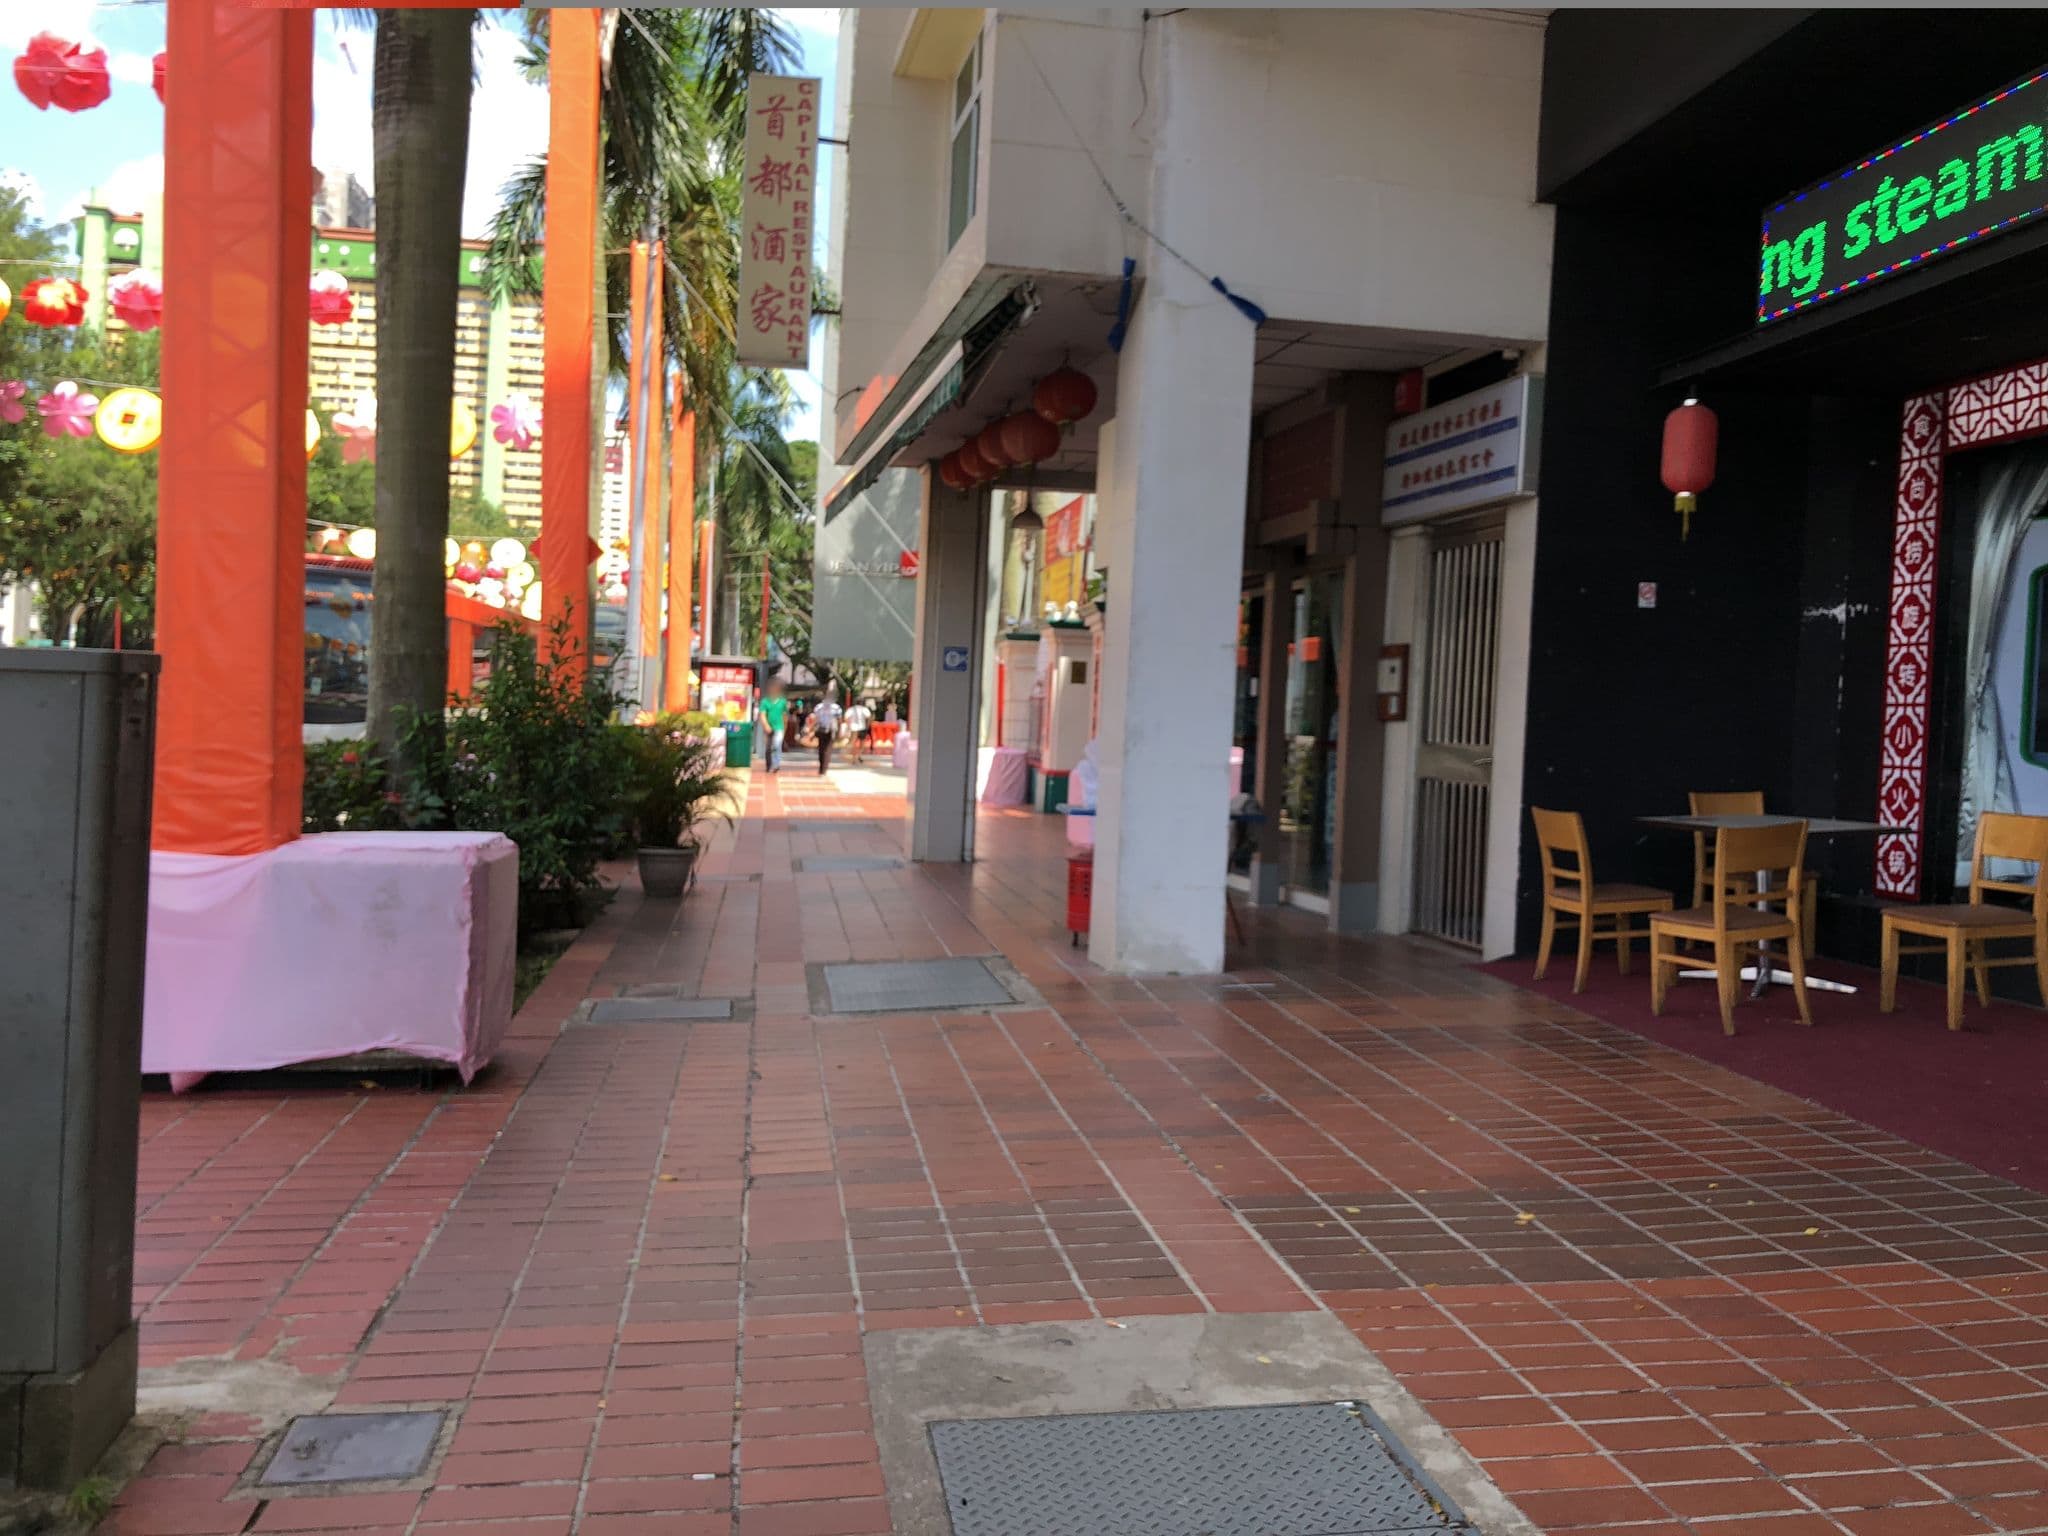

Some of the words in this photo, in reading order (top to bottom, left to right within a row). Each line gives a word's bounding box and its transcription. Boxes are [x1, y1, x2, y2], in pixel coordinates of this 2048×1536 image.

[795, 81, 813, 192] CAPITAL
[1844, 124, 2043, 259] steam
[749, 94, 794, 333] 首都酒家
[787, 201, 808, 359] RESTAURANT
